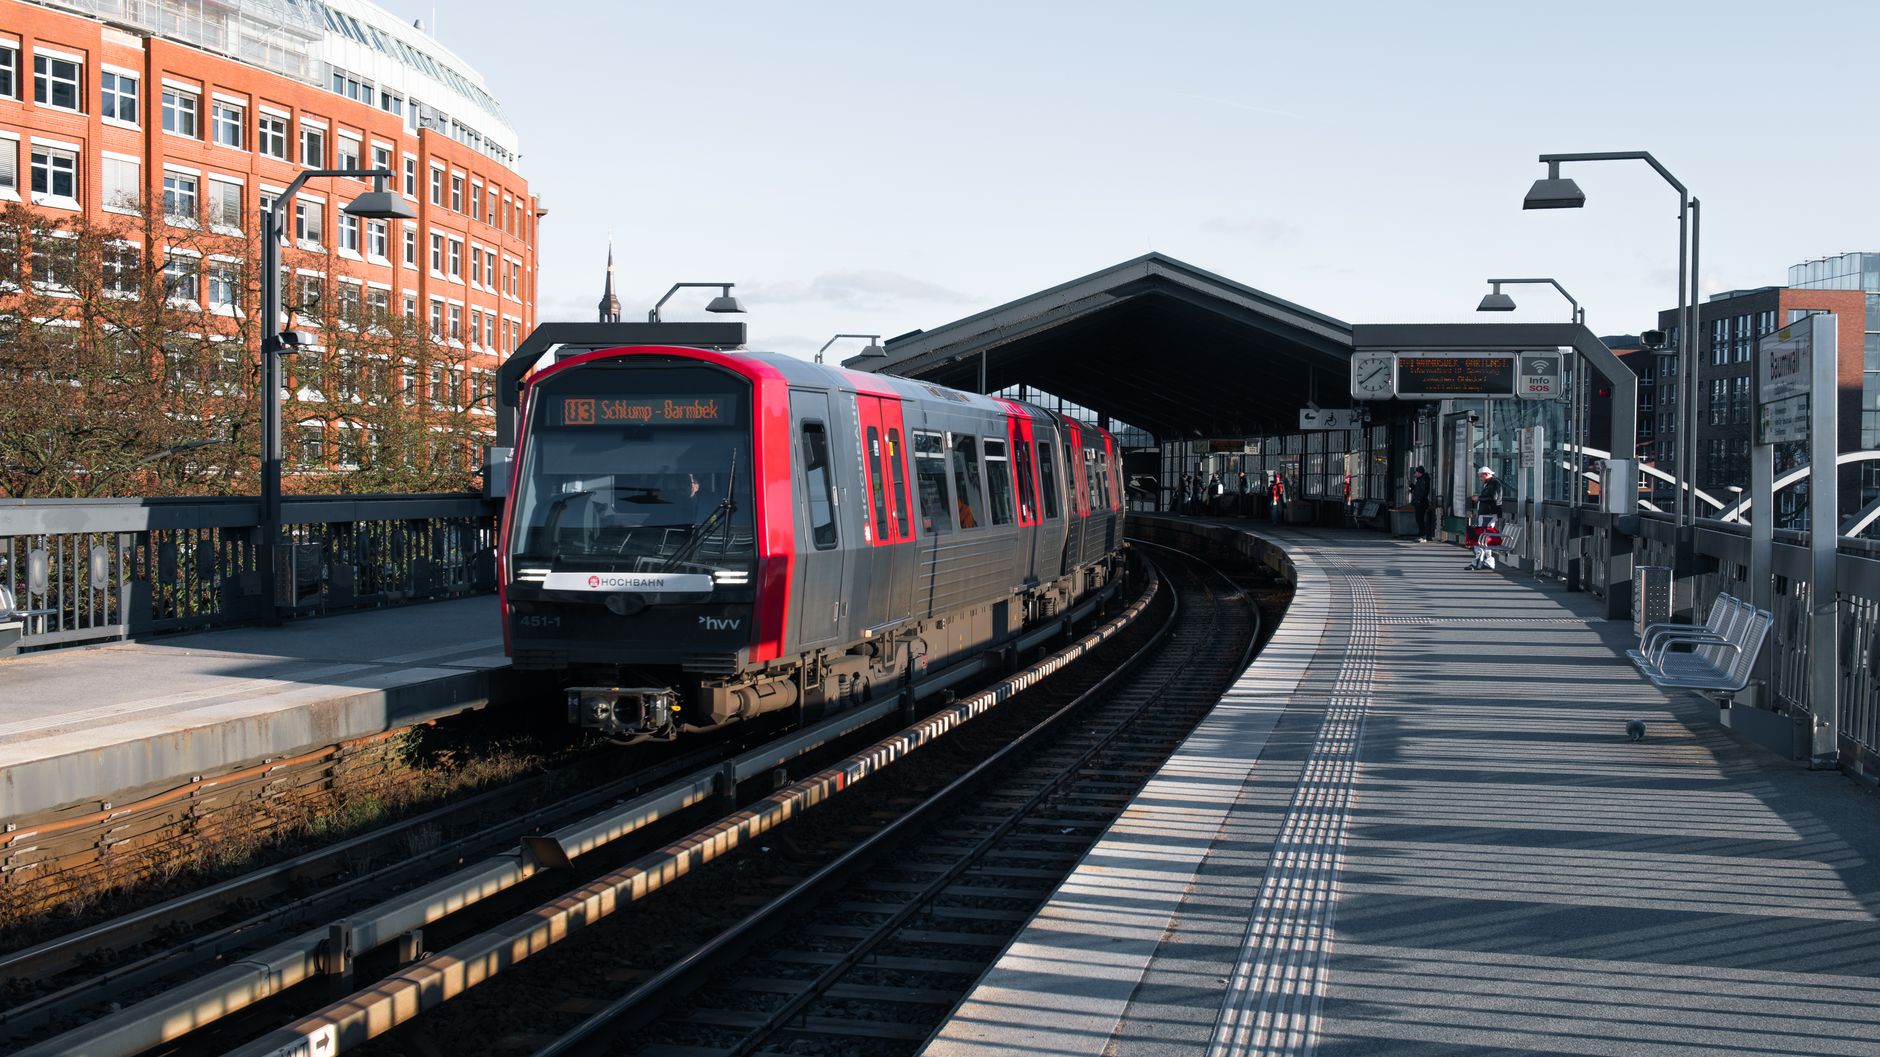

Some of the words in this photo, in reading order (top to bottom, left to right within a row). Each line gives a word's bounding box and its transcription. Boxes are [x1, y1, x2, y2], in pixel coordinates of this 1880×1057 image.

[1770, 340, 1800, 380] Baumwall
[565, 401, 594, 423] U3
[600, 400, 652, 422] Schlump
[663, 400, 718, 419] Barmbek
[601, 578, 664, 587] HOCHBAHN
[520, 615, 561, 627] 451-1
